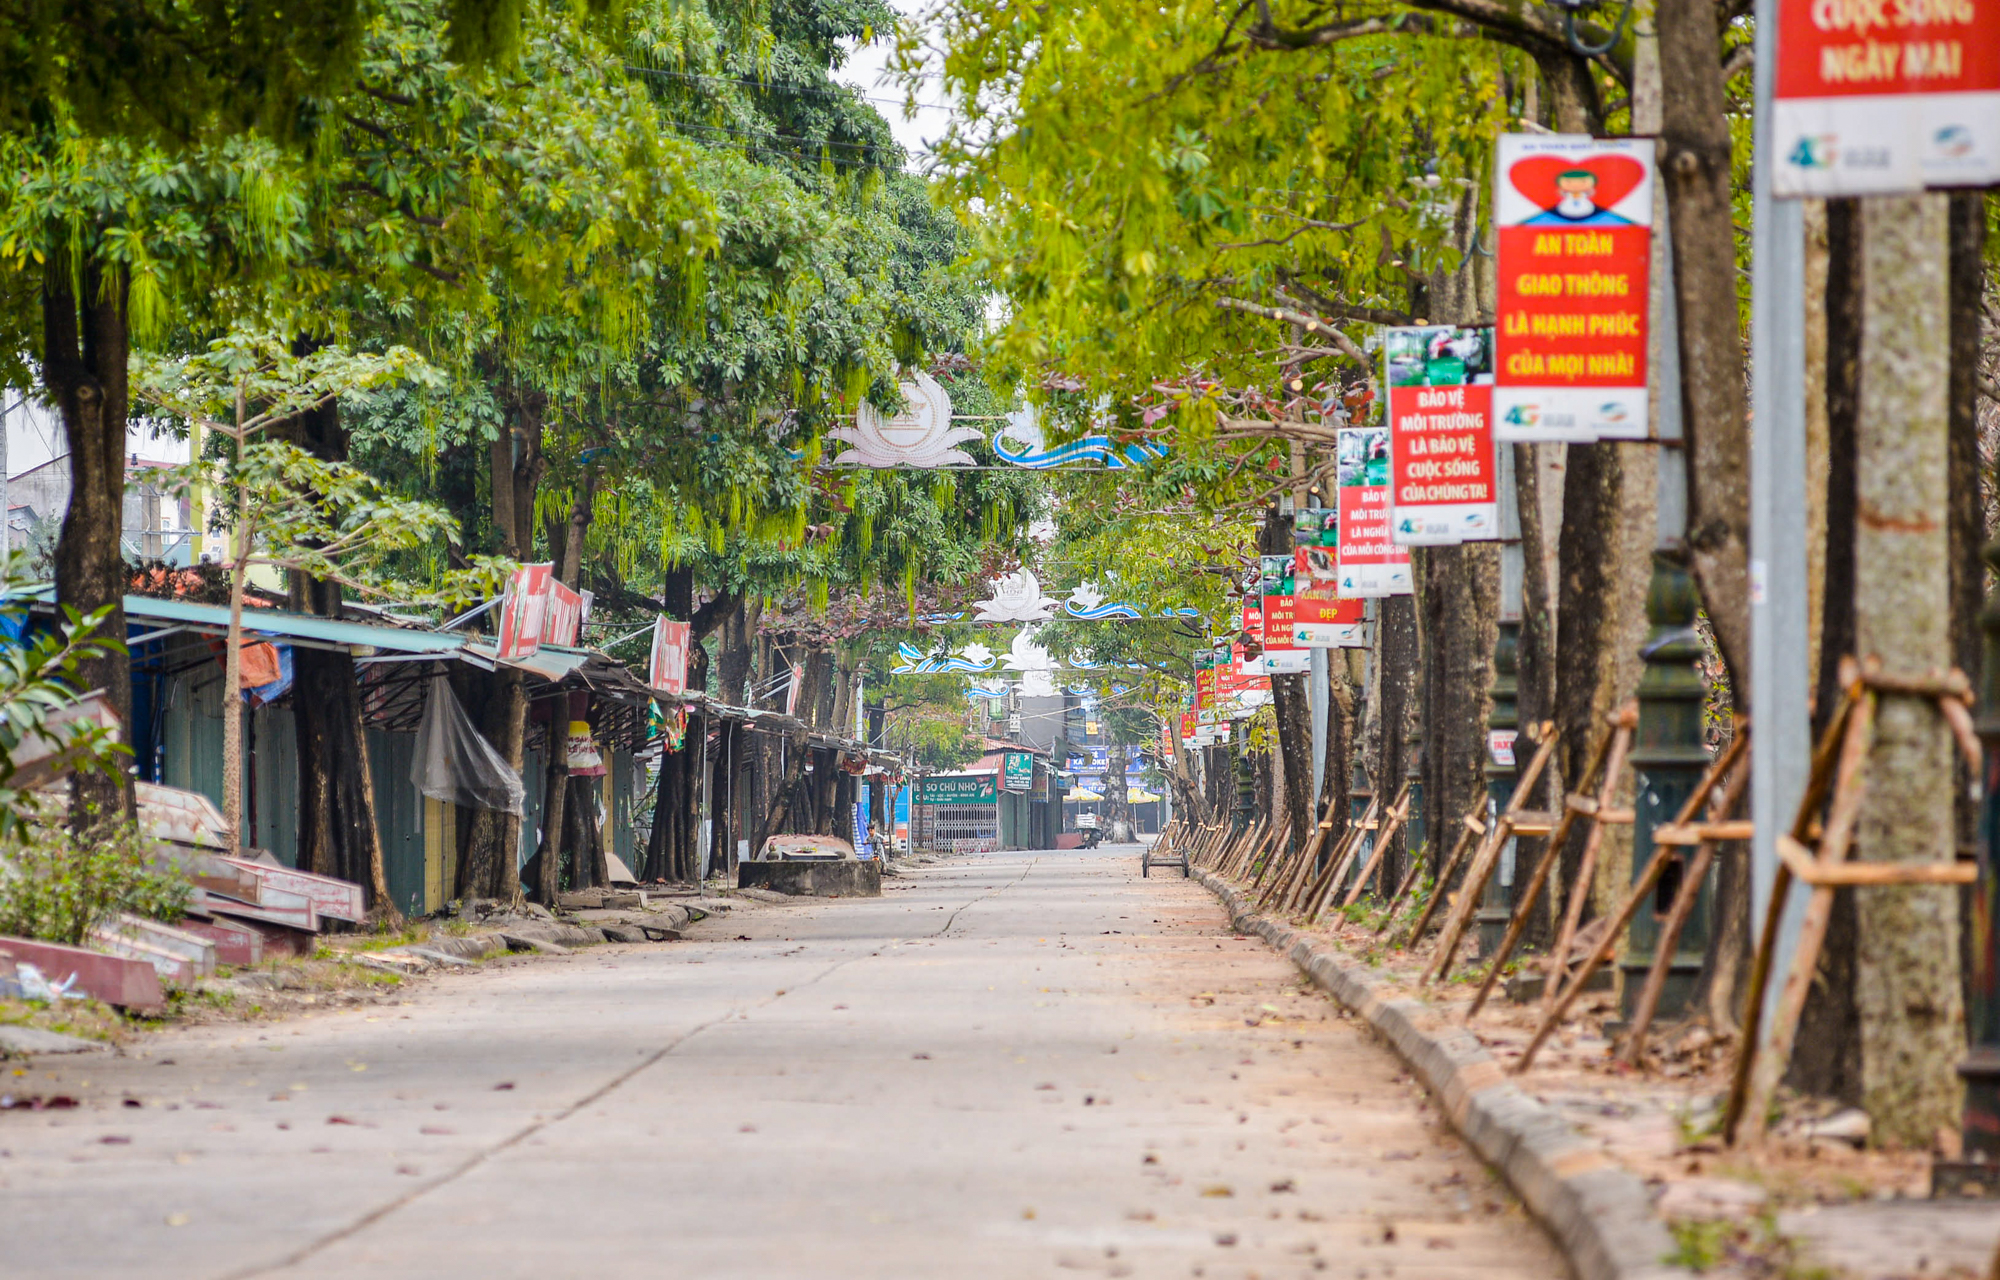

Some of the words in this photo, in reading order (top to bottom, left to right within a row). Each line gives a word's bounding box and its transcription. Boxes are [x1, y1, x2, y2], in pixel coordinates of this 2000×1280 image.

[1820, 38, 1899, 83] NGÀY
[1902, 41, 1963, 79] MAI
[1788, 133, 1838, 169] 4G
[1534, 234, 1561, 256] AN
[1565, 230, 1613, 256] TOÀN
[1516, 273, 1562, 296] GIAO
[1566, 269, 1629, 296] THÔNG
[1504, 310, 1529, 336] LÀ
[1531, 314, 1585, 341] HẠNH
[1589, 310, 1640, 336] PHÚC
[1507, 348, 1545, 376] CỦA
[1547, 354, 1584, 381] MỌI
[1588, 350, 1635, 377] NHÀ!
[1418, 388, 1446, 408] BẢO
[1448, 389, 1465, 410] VỆ
[1401, 412, 1427, 432] MÔI
[1429, 411, 1484, 430] TRƯỜNG
[1504, 403, 1540, 426] 4G
[1410, 436, 1427, 455] LÀ
[1430, 434, 1456, 454] BẢO
[1458, 434, 1476, 456] VỆ
[1407, 460, 1442, 481] CUỘC
[1444, 457, 1480, 477] SỐNG
[1362, 489, 1379, 503] BẢO
[1402, 482, 1426, 501] CỦA
[1427, 482, 1467, 500] CHÚNG
[1469, 483, 1487, 499] TA!
[1351, 508, 1367, 521] MÔI
[1351, 525, 1361, 538] LÀ
[1363, 524, 1389, 538] NGHĨA
[1399, 518, 1423, 533] 4G
[1342, 543, 1357, 556] CỦA
[1374, 543, 1394, 555] CÔNG
[1280, 598, 1293, 607] BẢO
[1272, 611, 1284, 620] MÔI
[1319, 608, 1338, 621] ĐẸP
[1272, 623, 1281, 632] LÀ
[1265, 635, 1277, 645] CỦA
[958, 782, 977, 792] NHO
